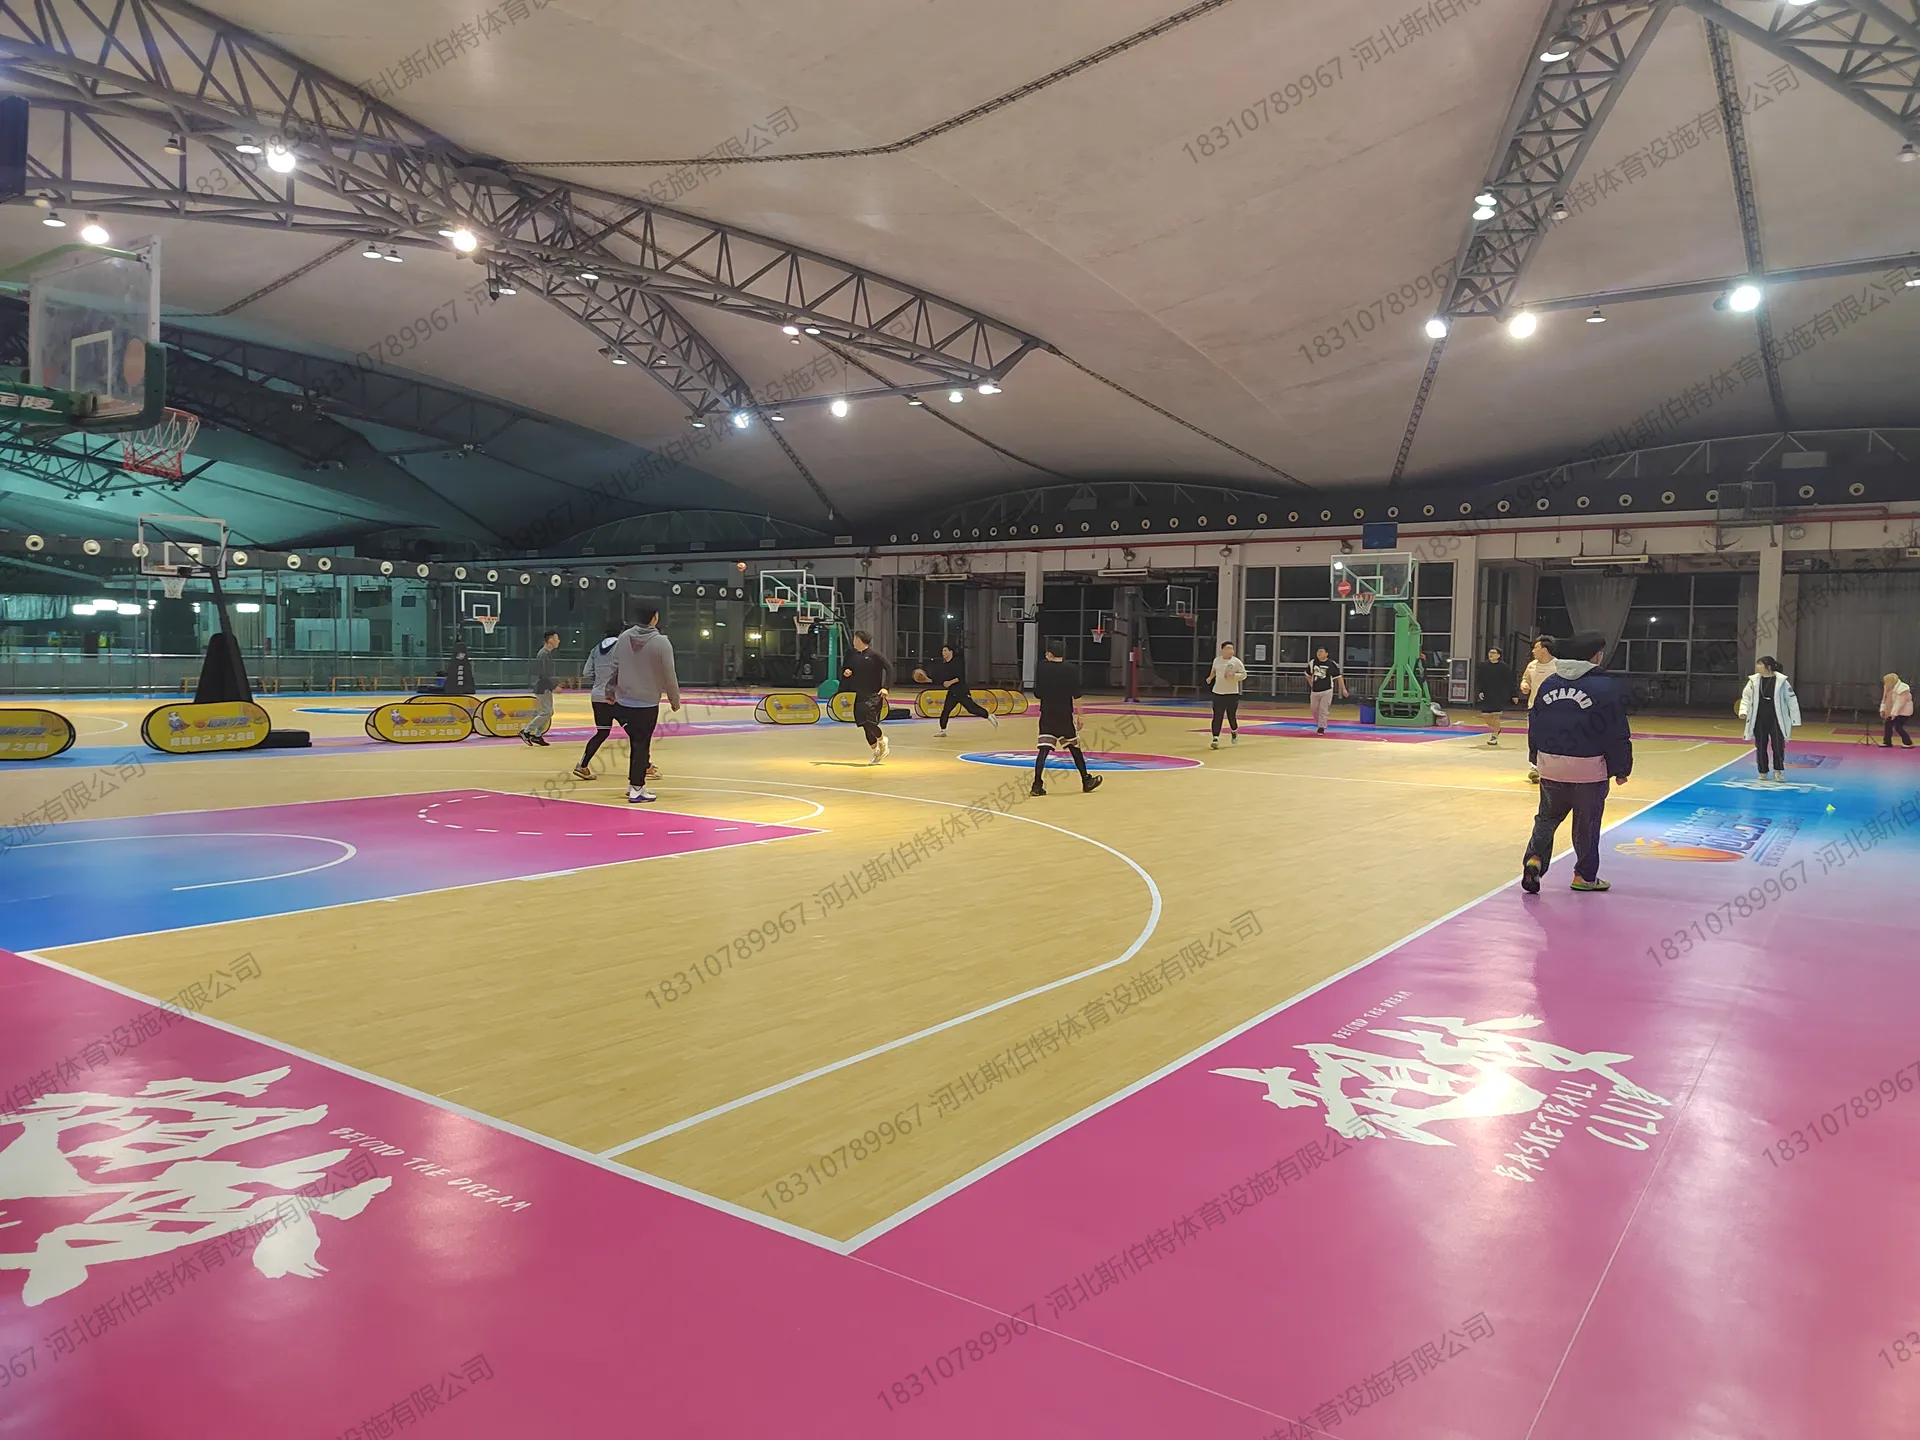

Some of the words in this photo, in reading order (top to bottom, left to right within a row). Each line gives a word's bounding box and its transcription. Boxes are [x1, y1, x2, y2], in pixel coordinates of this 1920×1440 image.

[1332, 1018, 1369, 1039] BEYOND
[1364, 1007, 1386, 1020] THE
[1380, 991, 1413, 1008] DREAM
[1491, 1080, 1598, 1182] BASKETBALL
[1585, 1084, 1672, 1151] CLUB
[329, 1127, 405, 1157] BEYOND
[403, 1157, 451, 1177] THE
[447, 1177, 531, 1213] DREAM
